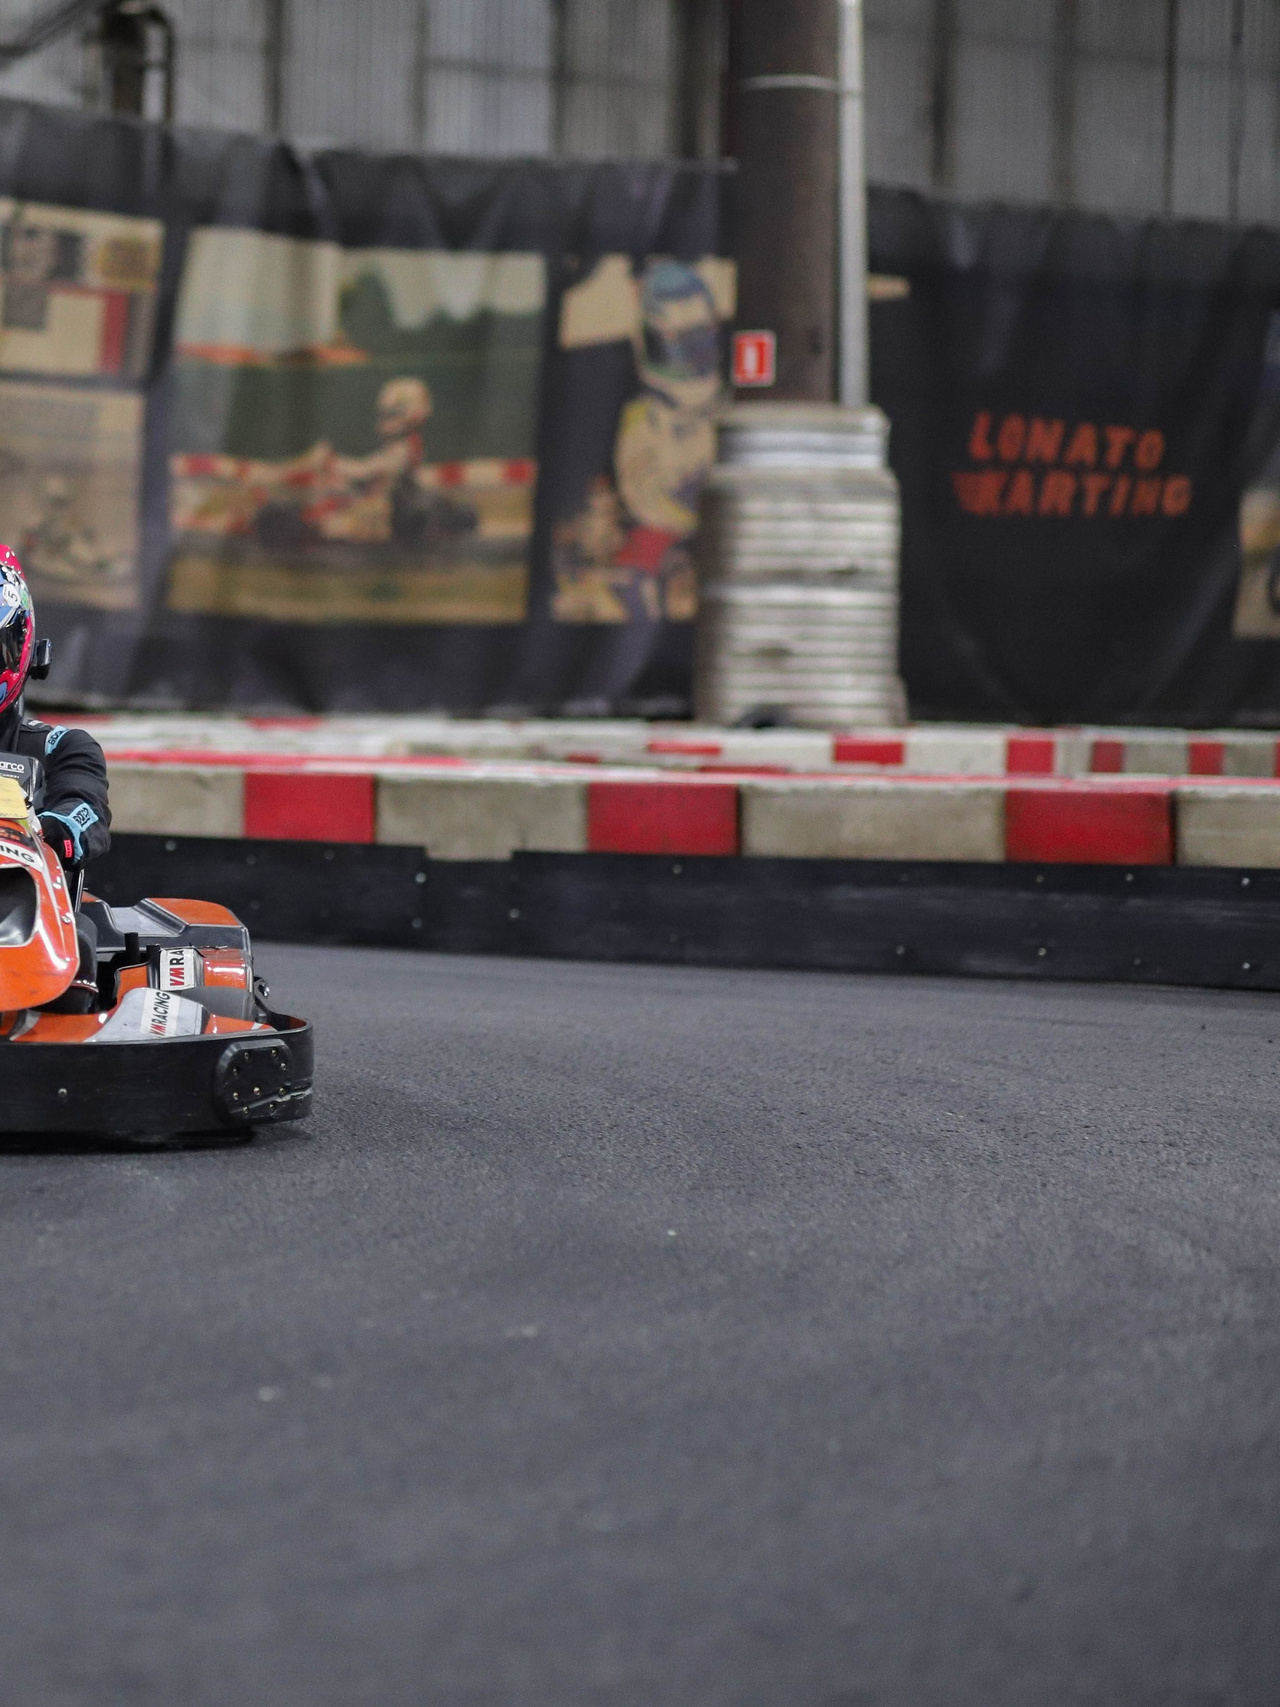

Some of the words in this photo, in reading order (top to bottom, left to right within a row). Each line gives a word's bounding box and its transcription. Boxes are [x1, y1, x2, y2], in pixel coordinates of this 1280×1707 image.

[970, 410, 1165, 471] LONATO
[952, 468, 1191, 517] KARTING
[8, 591, 18, 602] 5
[170, 950, 185, 987] VMRA
